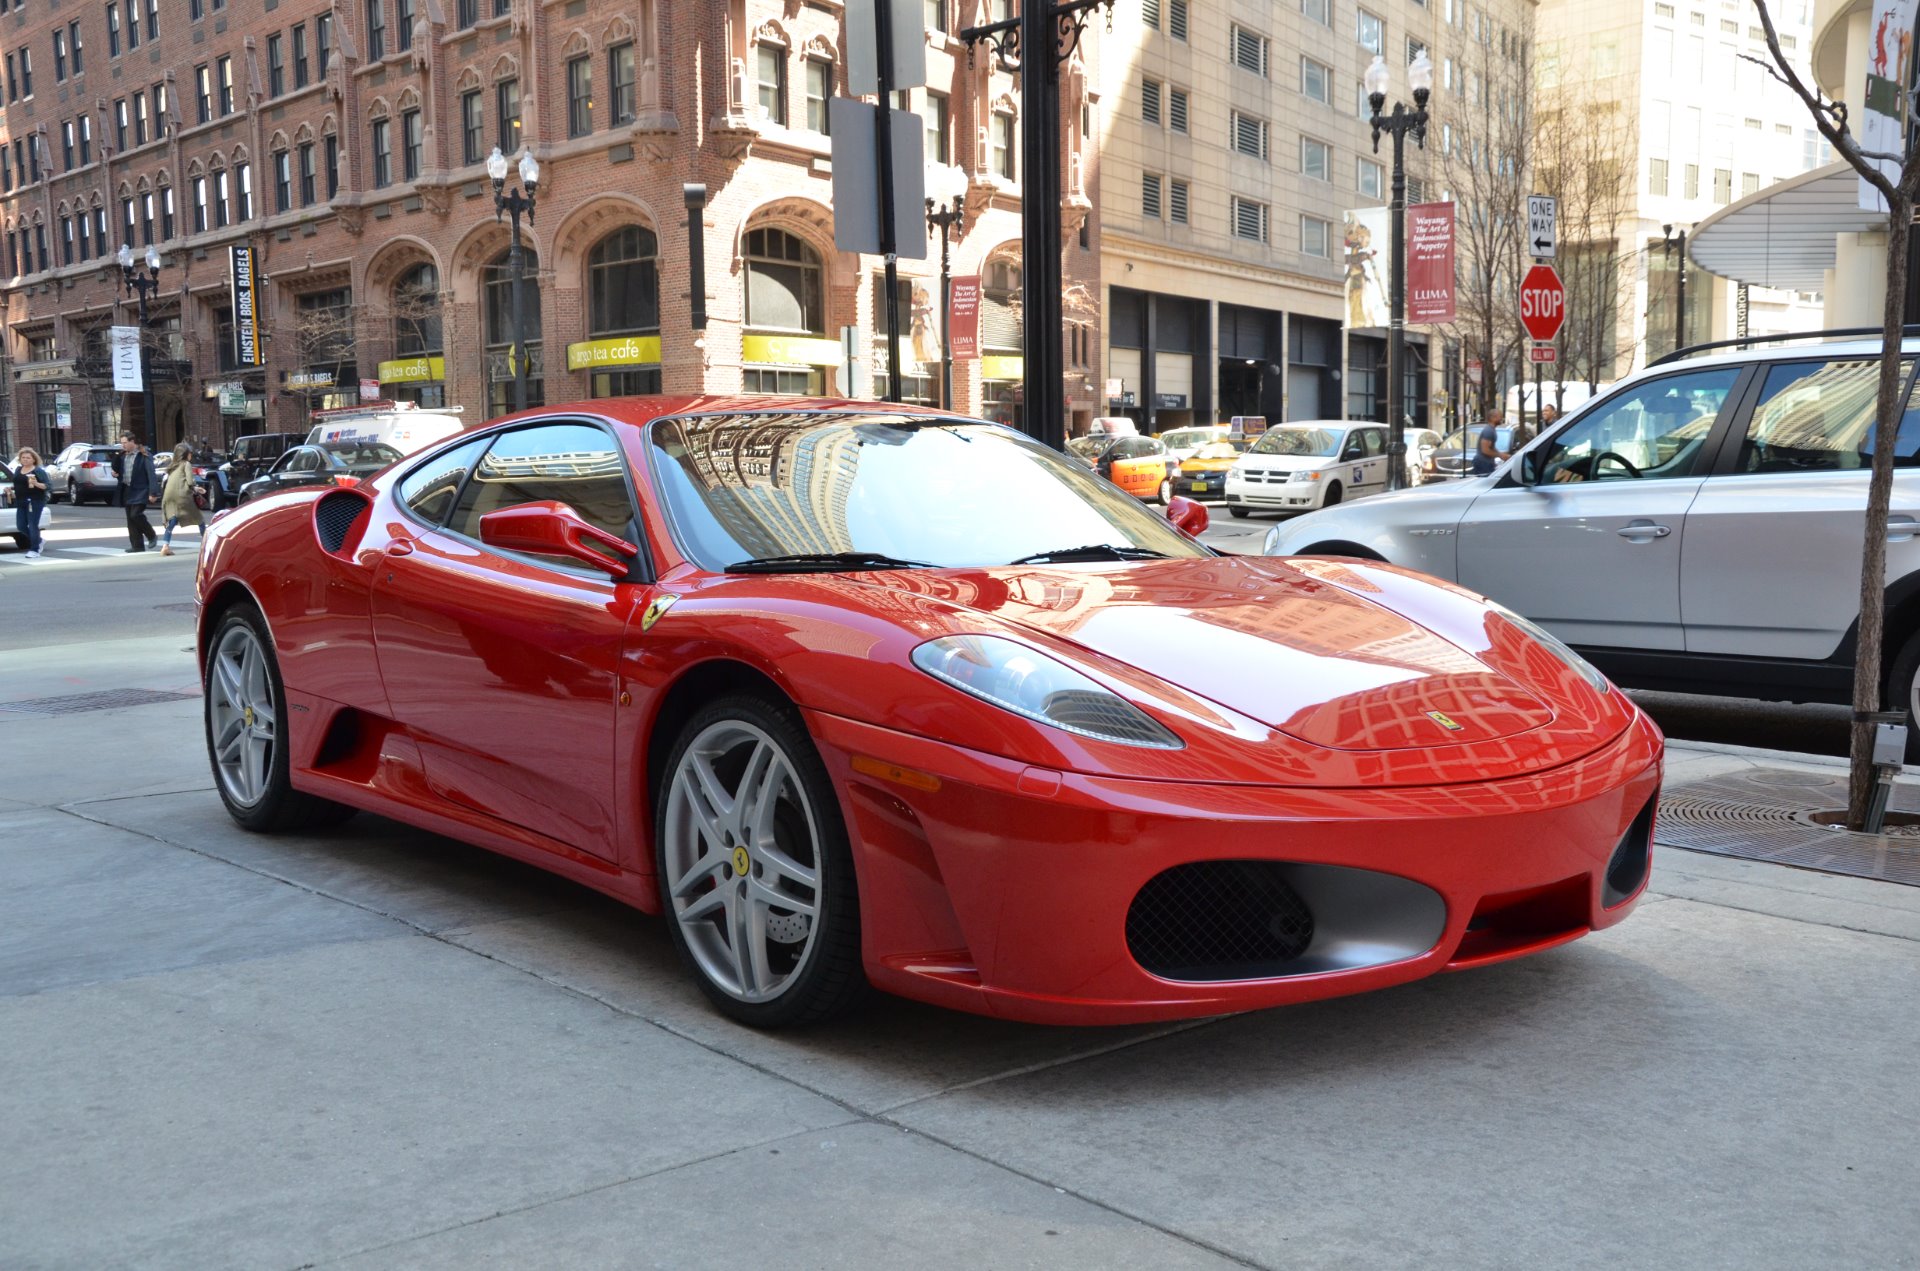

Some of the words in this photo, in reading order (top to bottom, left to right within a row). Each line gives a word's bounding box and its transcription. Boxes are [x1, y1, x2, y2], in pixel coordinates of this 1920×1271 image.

[1531, 201, 1552, 216] ONE
[1416, 217, 1448, 226] Wayang:
[1441, 223, 1449, 233] of
[1531, 218, 1553, 233] WAY
[1413, 234, 1450, 242] Indonesian
[1416, 243, 1448, 252] Puppetry
[237, 249, 251, 287] BAGELS
[1415, 289, 1448, 300] LUMA
[1522, 288, 1562, 318] STOP
[1737, 288, 1747, 347] NORDSTRO
[240, 319, 254, 363] EINSTEIN
[953, 336, 974, 345] LUMA
[593, 347, 607, 360] tea
[610, 339, 639, 359] café
[1532, 350, 1542, 360] ALL
[1543, 350, 1554, 360] WAY
[405, 360, 428, 376] café
[314, 373, 332, 383] BAGELS
